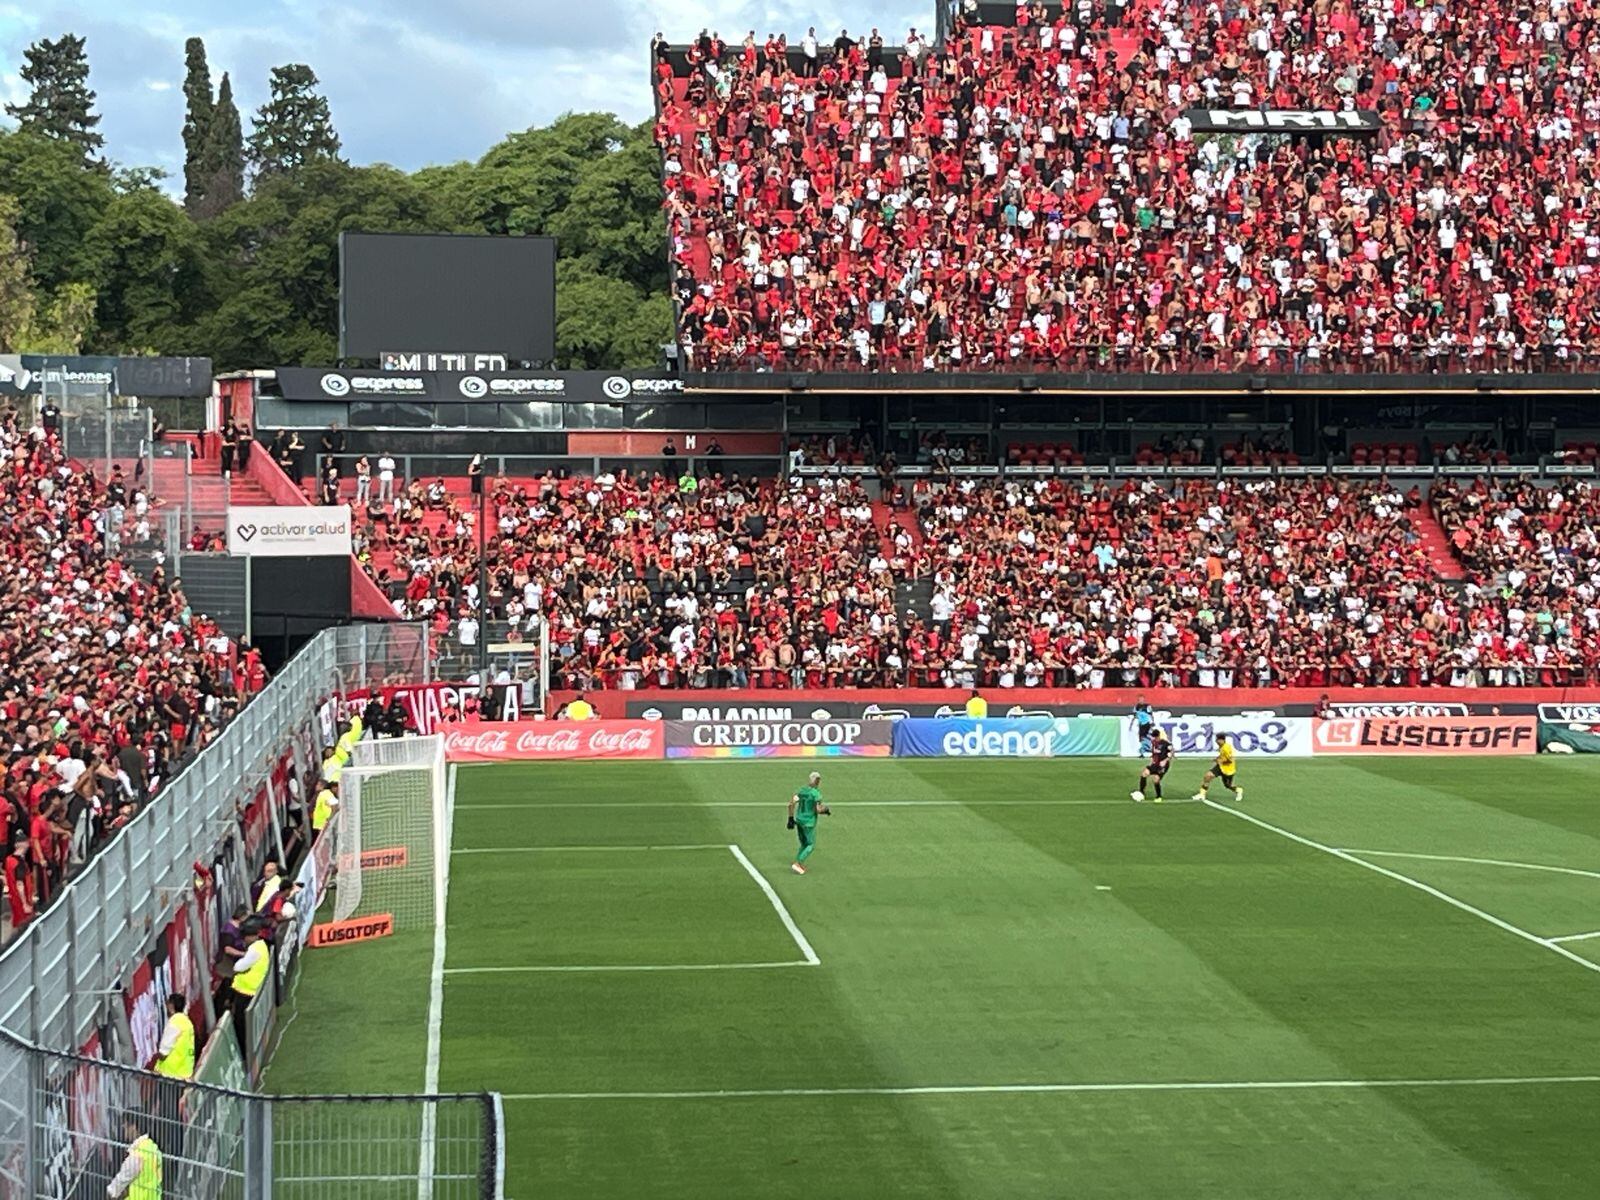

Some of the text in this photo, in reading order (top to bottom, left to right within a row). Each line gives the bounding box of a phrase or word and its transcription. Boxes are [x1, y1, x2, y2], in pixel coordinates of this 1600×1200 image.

[1209, 110, 1361, 126] MR11
[351, 377, 423, 391] express
[490, 378, 564, 394] express
[260, 521, 346, 536] activar salud
[681, 707, 792, 720] PALADINI
[692, 723, 861, 746] CREDICOOP
[943, 723, 1057, 756] edenor
